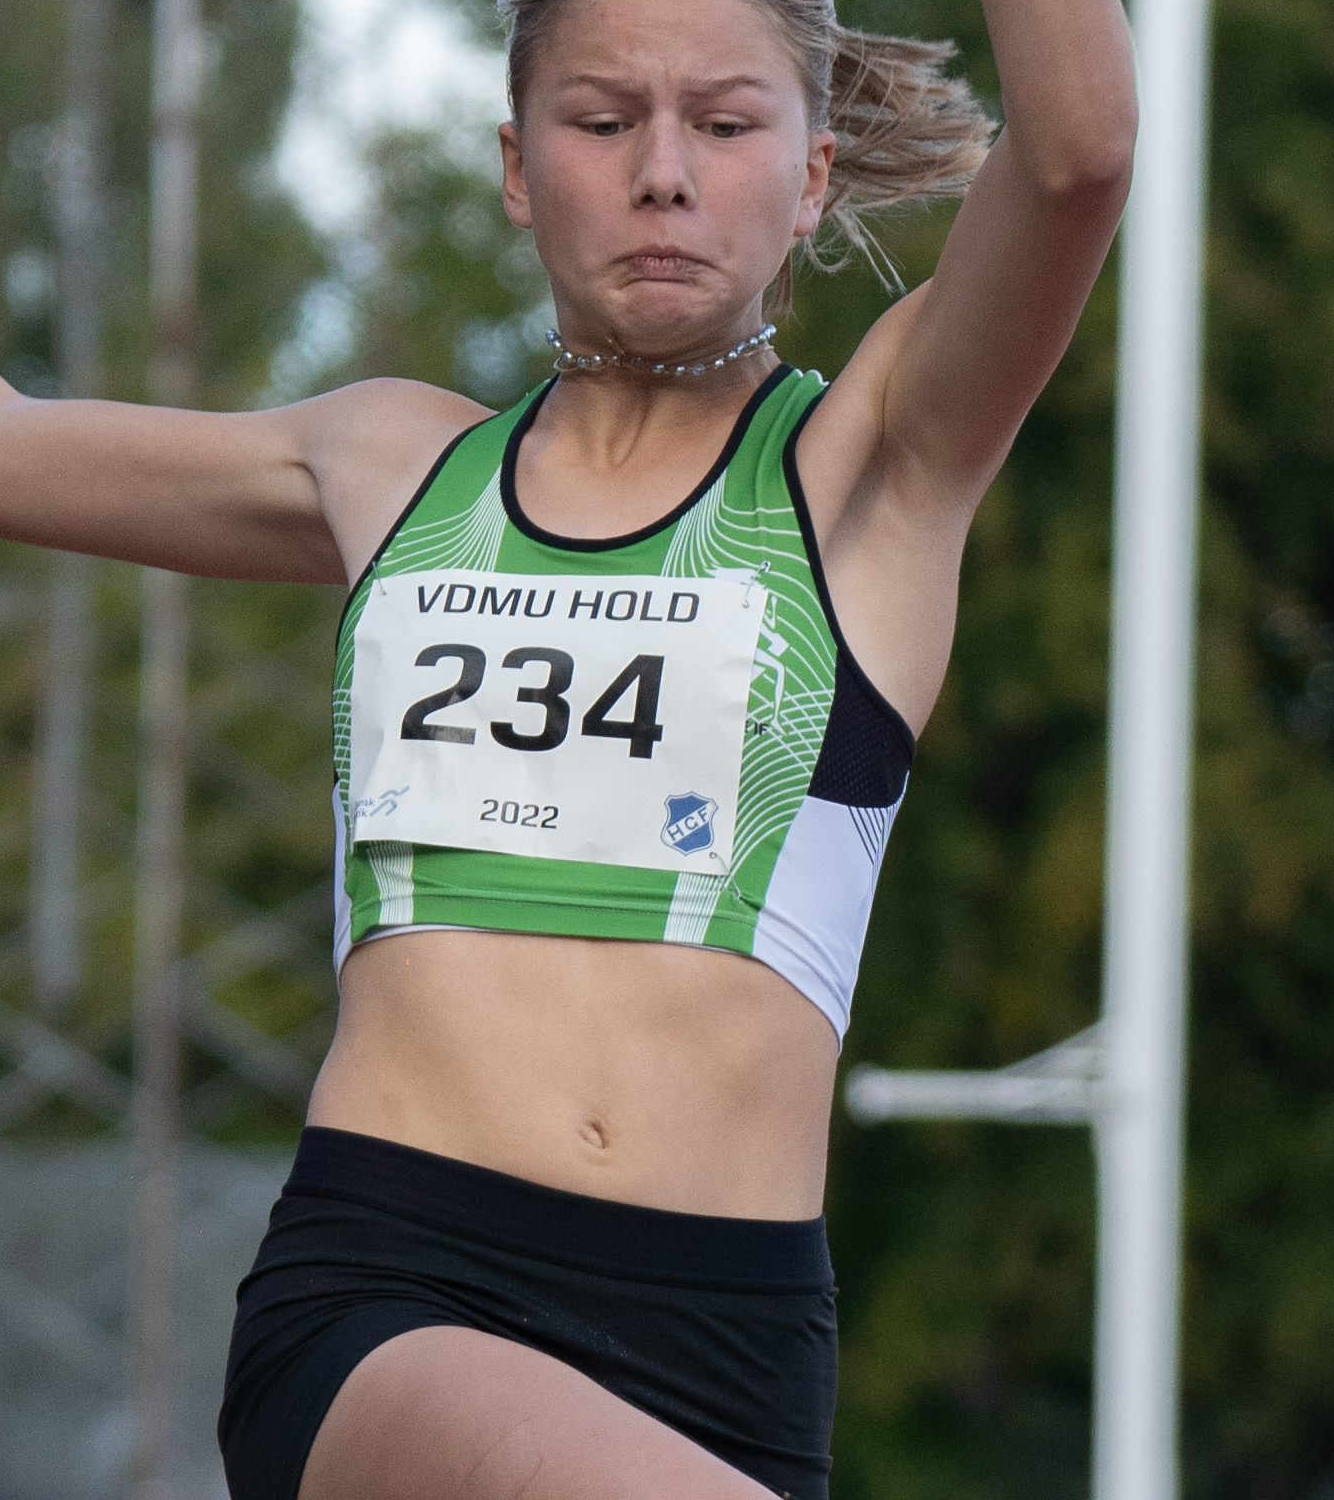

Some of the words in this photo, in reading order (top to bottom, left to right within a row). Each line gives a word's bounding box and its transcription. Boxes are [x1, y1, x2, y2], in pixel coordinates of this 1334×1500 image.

[417, 583, 556, 618] VDMU
[568, 589, 700, 623] HOLD
[400, 643, 665, 759] 234
[479, 798, 559, 830] 2022
[667, 805, 708, 842] HGF
